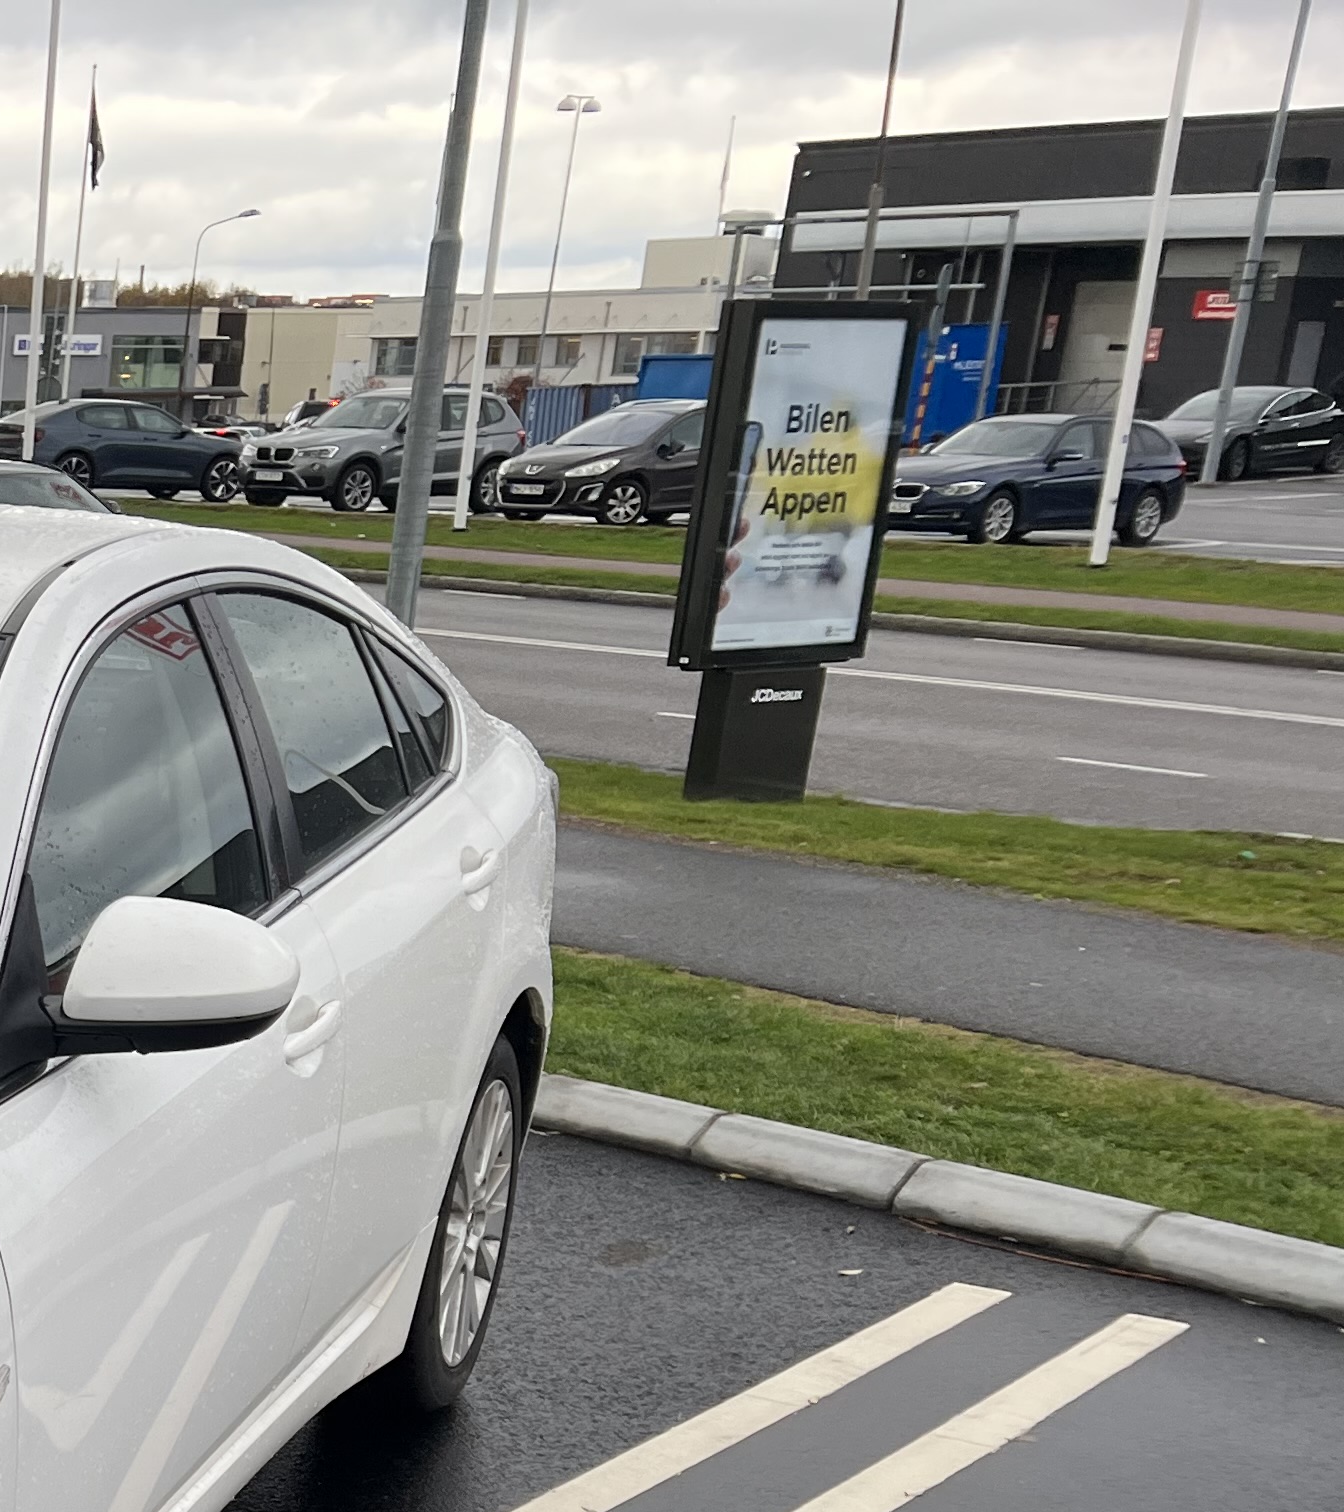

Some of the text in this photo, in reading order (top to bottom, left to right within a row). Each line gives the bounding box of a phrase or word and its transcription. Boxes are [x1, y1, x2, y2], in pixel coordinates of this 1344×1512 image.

[786, 403, 850, 433] Bilen
[767, 447, 857, 477] Watten
[760, 487, 847, 521] Appen
[751, 688, 803, 703] JCDecaux
